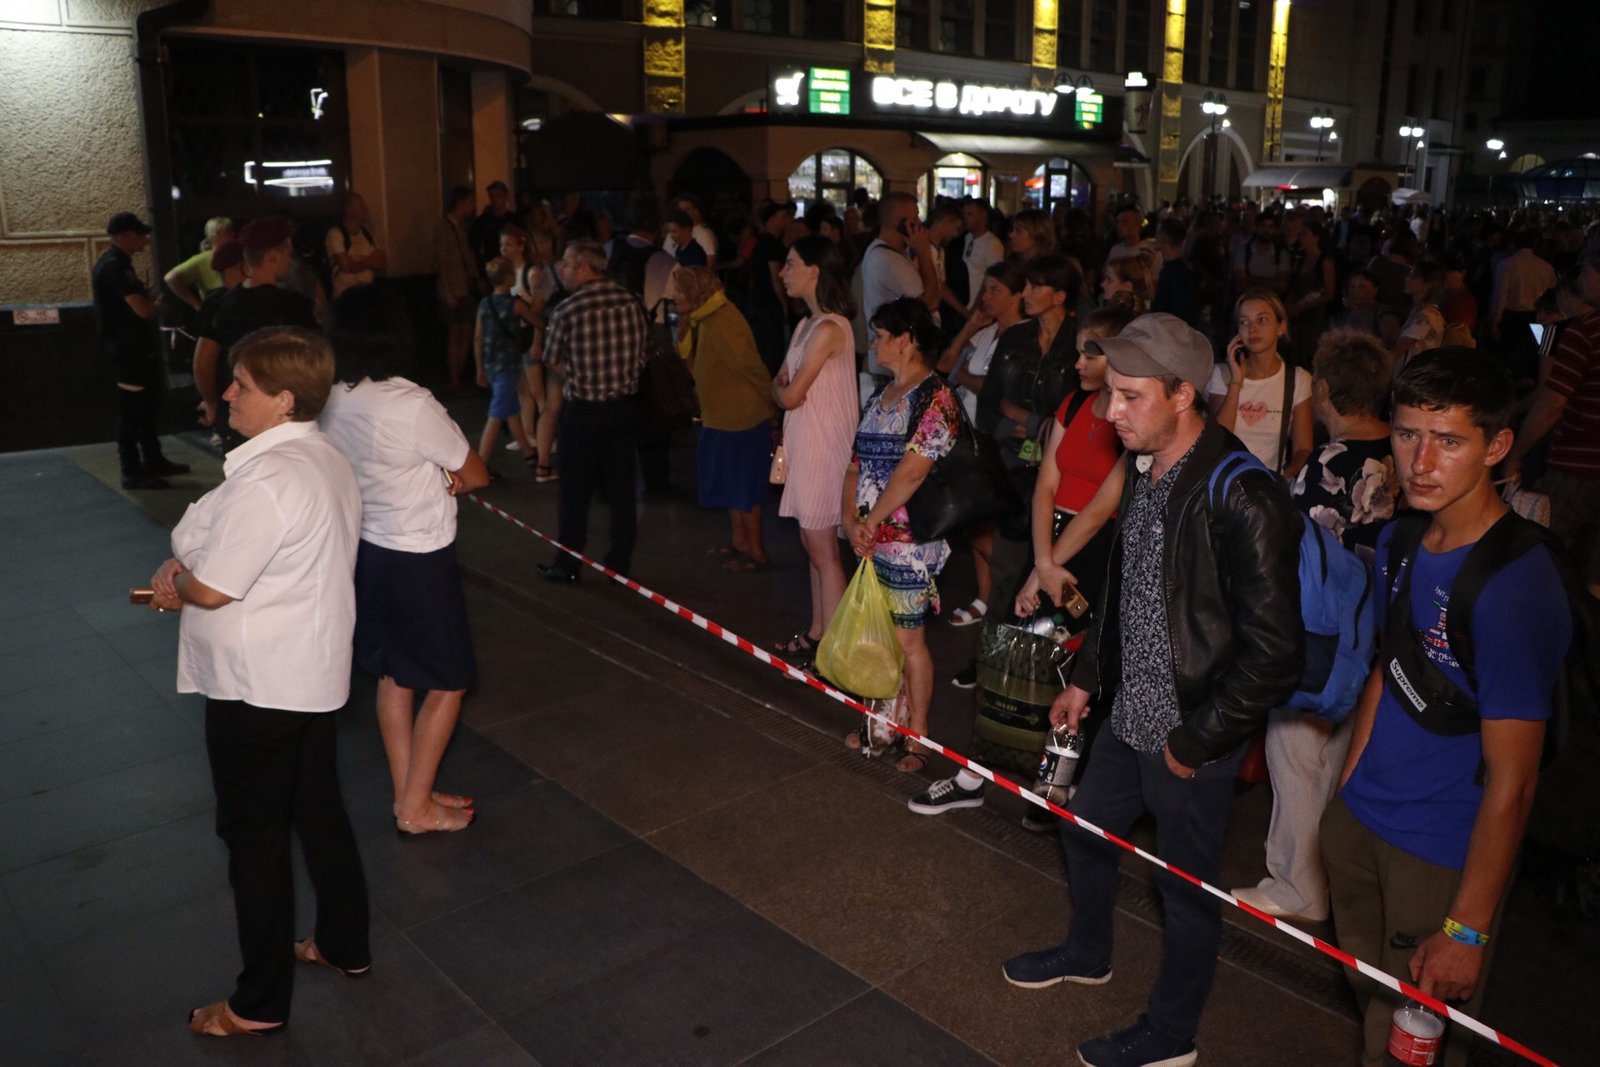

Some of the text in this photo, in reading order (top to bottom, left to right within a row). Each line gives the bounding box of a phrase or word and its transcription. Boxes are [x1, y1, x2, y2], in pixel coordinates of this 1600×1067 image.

[873, 76, 1057, 116] ВСЕ В ДОРОГУ
[1391, 661, 1425, 709] Supreme
